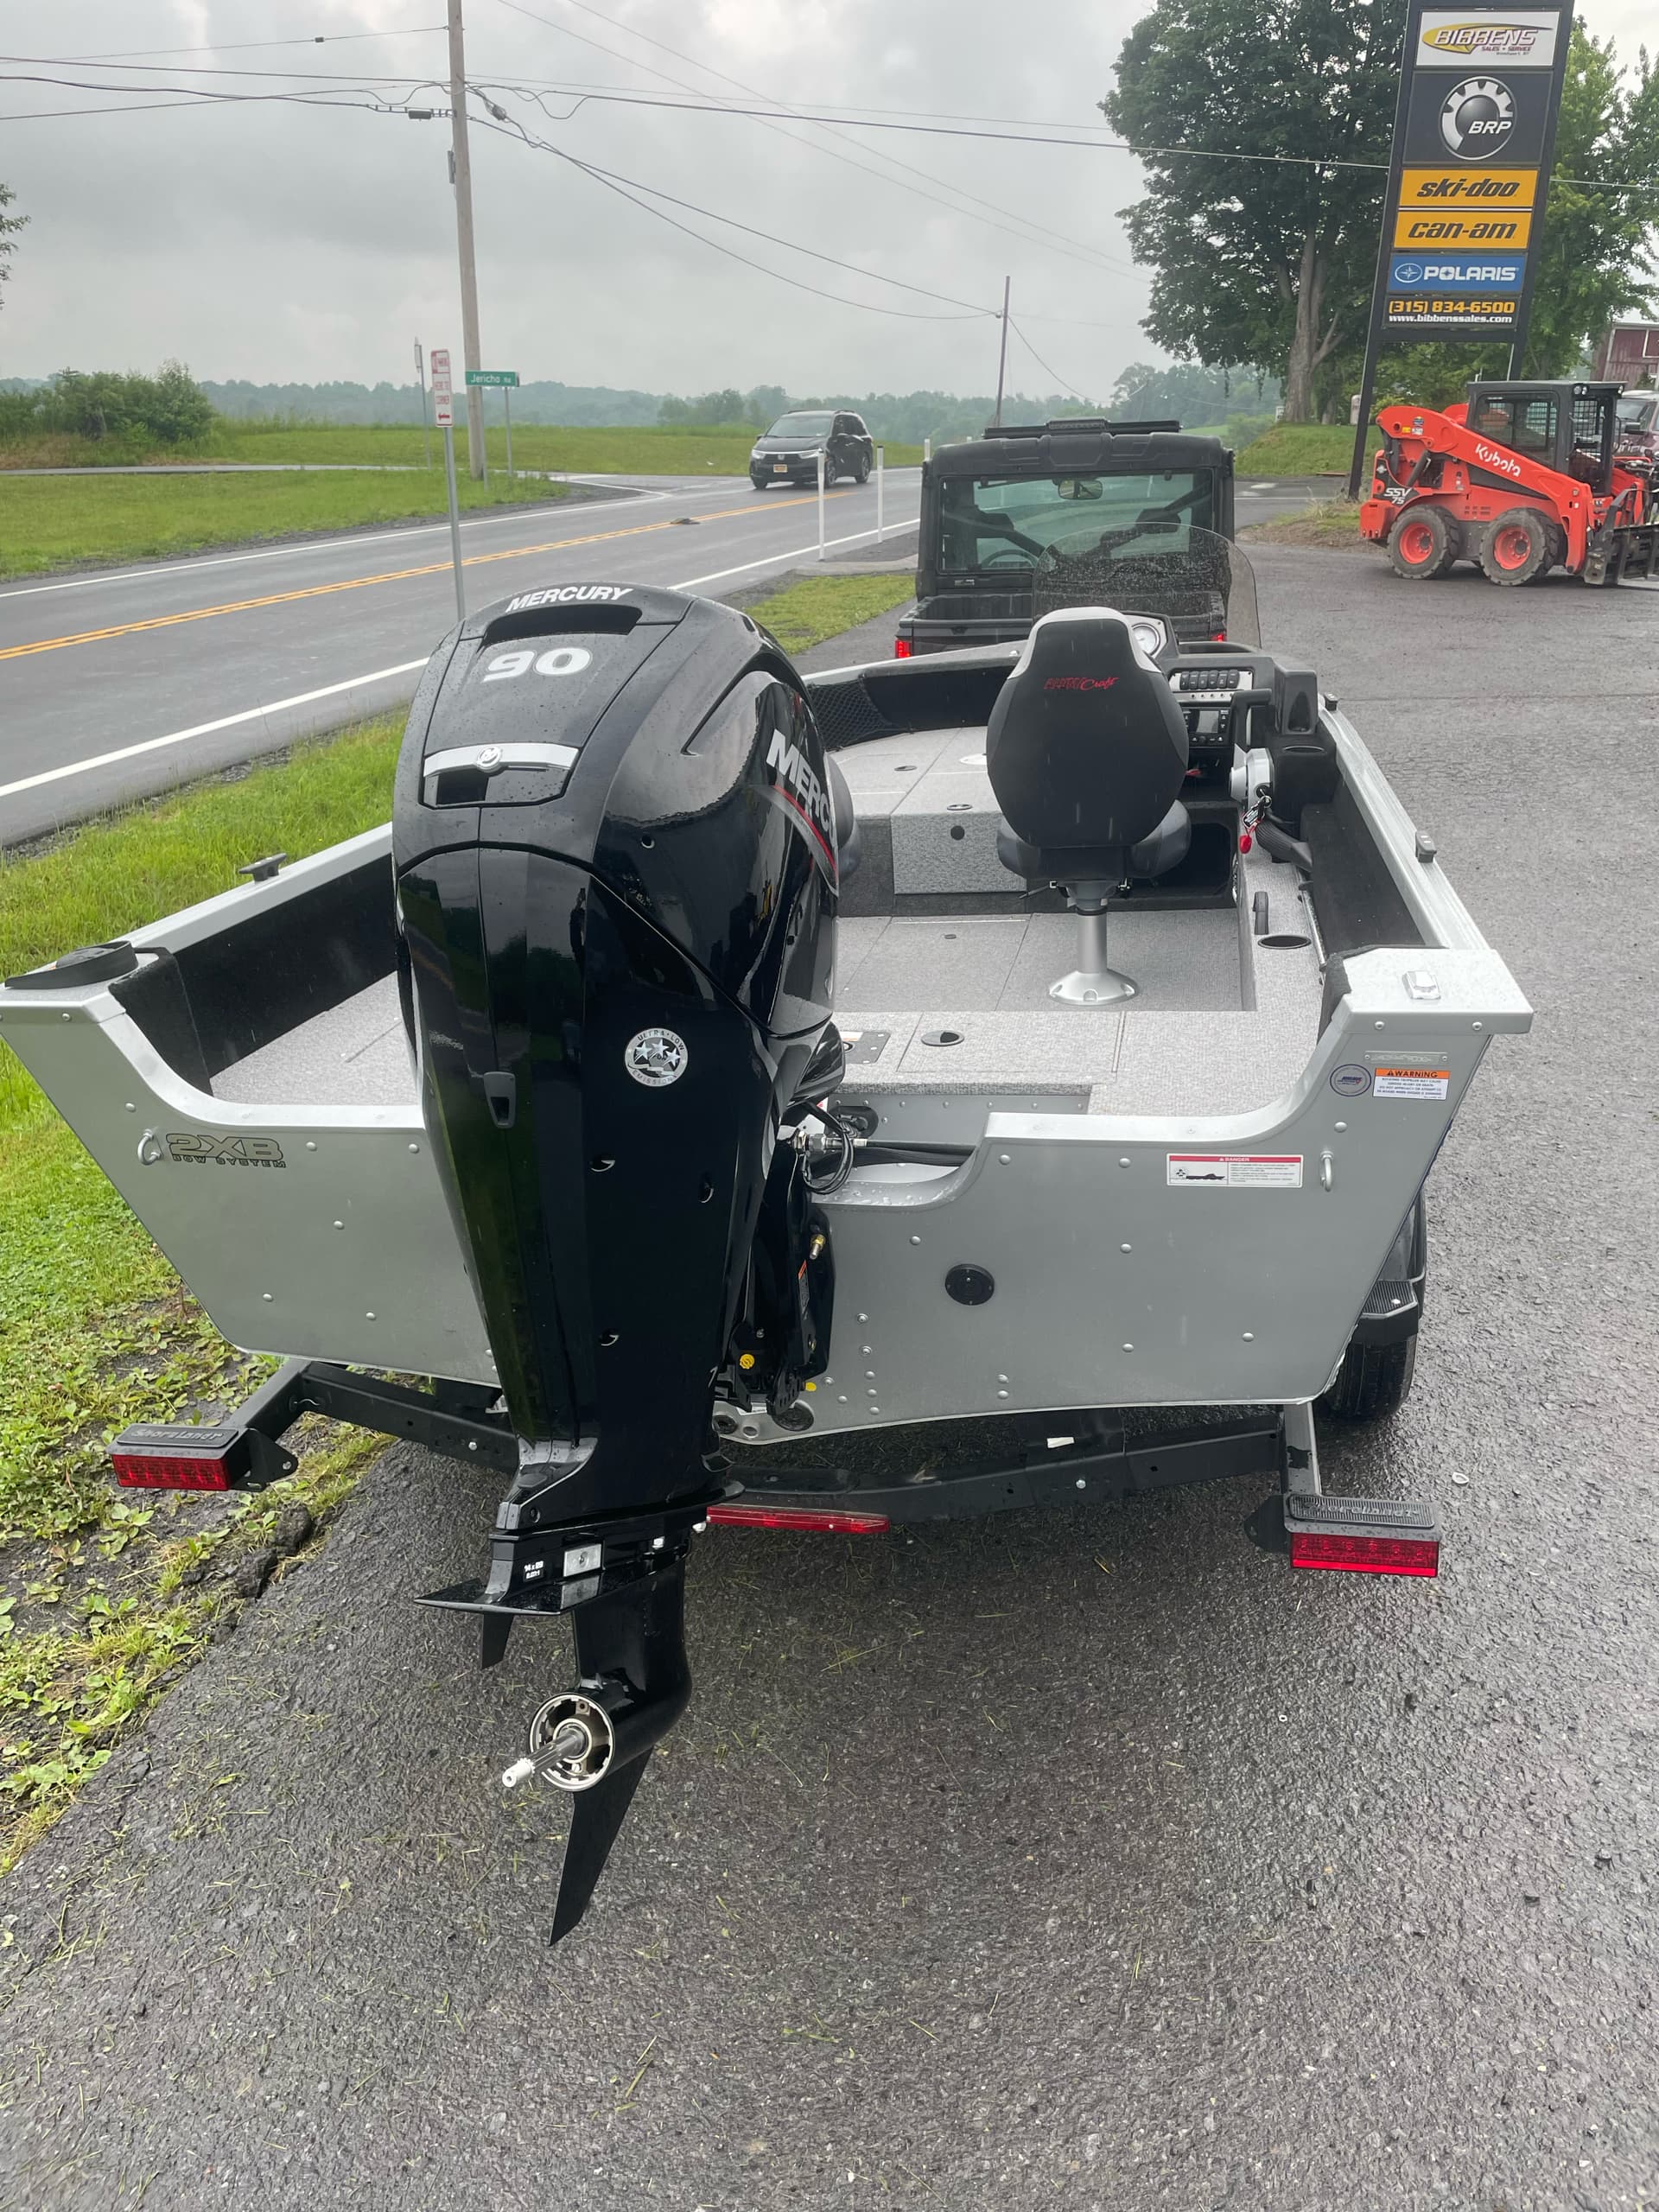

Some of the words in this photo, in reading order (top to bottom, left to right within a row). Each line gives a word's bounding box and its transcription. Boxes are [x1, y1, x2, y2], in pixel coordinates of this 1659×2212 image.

[1434, 29, 1538, 46] BIBBENS
[1468, 121, 1512, 135] BRP
[1416, 178, 1521, 198] ski-doo
[1408, 222, 1516, 239] can-am
[1424, 266, 1516, 282] POLARIS
[1389, 301, 1429, 314] (315)
[1432, 302, 1516, 314] 834-6500
[1389, 315, 1513, 324] www.bibbenssales.com
[470, 372, 500, 384] Jericho
[1474, 442, 1522, 477] Kubota
[1383, 486, 1413, 497] SSV
[505, 586, 634, 613] MERCURY
[482, 647, 593, 683] 90
[166, 1133, 283, 1160] 2XB
[216, 1156, 287, 1168] SYSTEM
